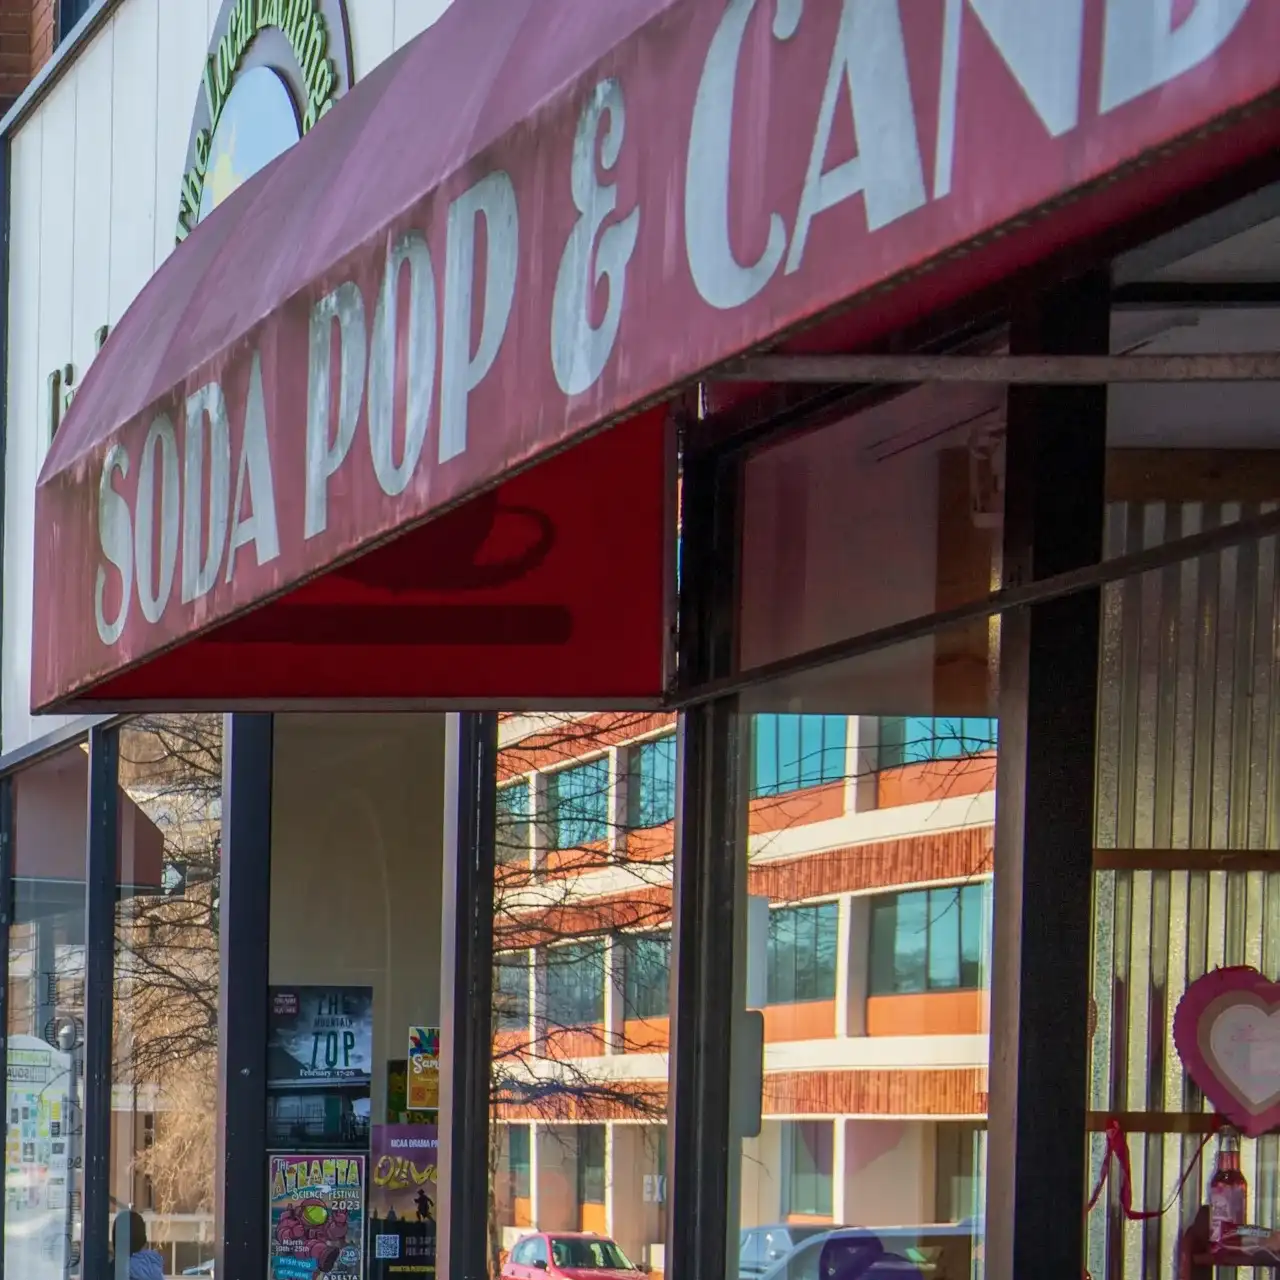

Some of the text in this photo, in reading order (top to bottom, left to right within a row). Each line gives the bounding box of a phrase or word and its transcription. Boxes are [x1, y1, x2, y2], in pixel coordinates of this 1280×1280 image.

[95, 340, 282, 645] SODA
[303, 169, 518, 538] POP
[550, 78, 638, 396] &
[311, 1030, 355, 1069] TOP
[299, 1069, 331, 1078] February
[271, 1158, 360, 1199] ATLANTA
[291, 1189, 360, 1201] SCIENCE FESTIVAL
[331, 1201, 360, 1210] 2023
